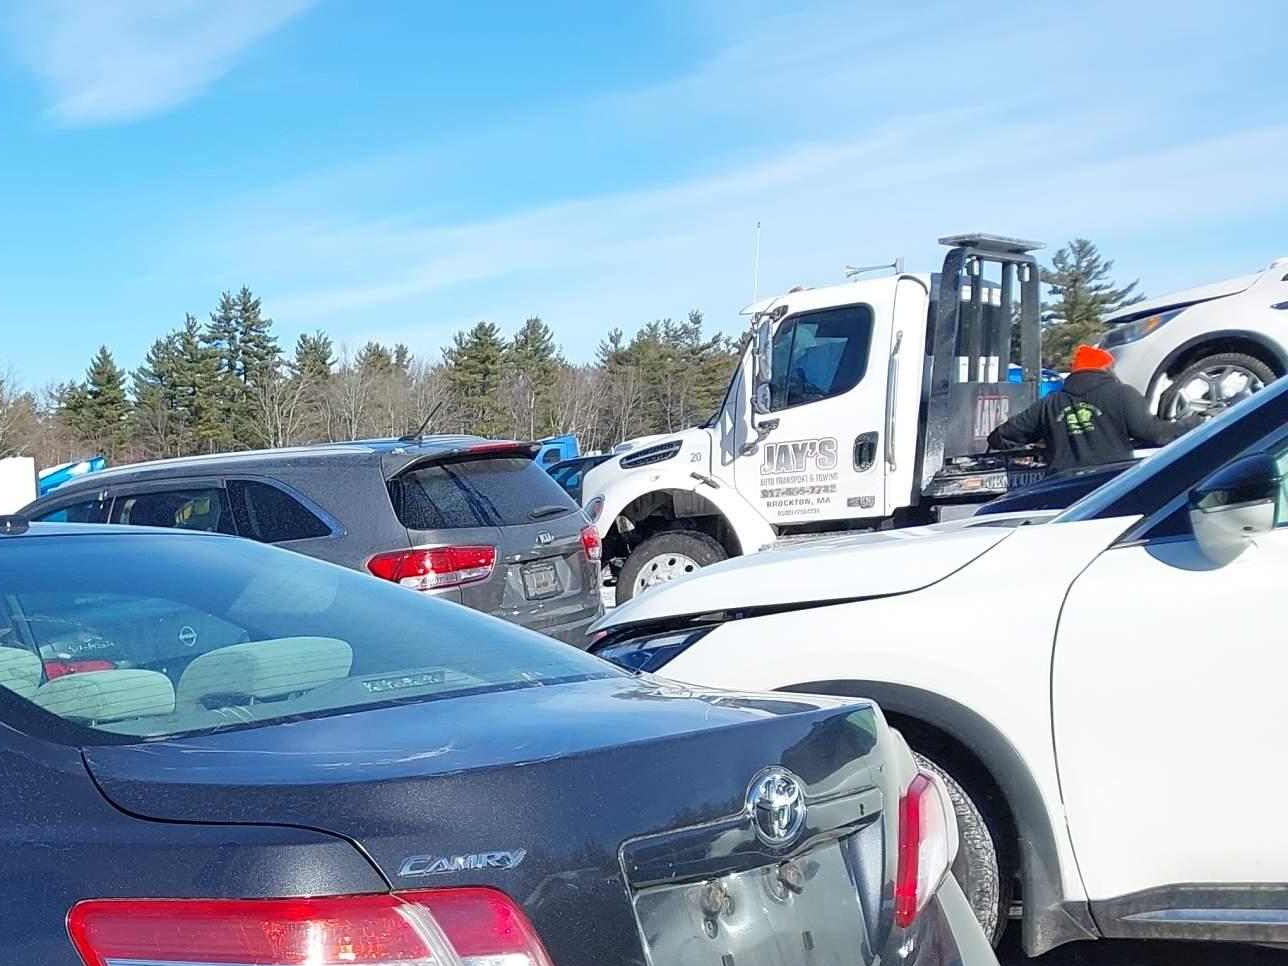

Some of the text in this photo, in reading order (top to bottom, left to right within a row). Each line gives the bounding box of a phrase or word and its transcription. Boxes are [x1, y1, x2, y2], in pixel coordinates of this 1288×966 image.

[974, 395, 1009, 440] JAY'S
[690, 452, 702, 463] 20
[760, 437, 838, 475] JAY'S
[760, 477, 775, 487] AUTO
[775, 474, 808, 486] TRANSPORT
[816, 472, 839, 483] TOWING
[985, 471, 1046, 489] CENTURY
[766, 496, 831, 508] BROCKTON, MA
[538, 532, 553, 544] KIA
[398, 848, 528, 877] CAMRY
